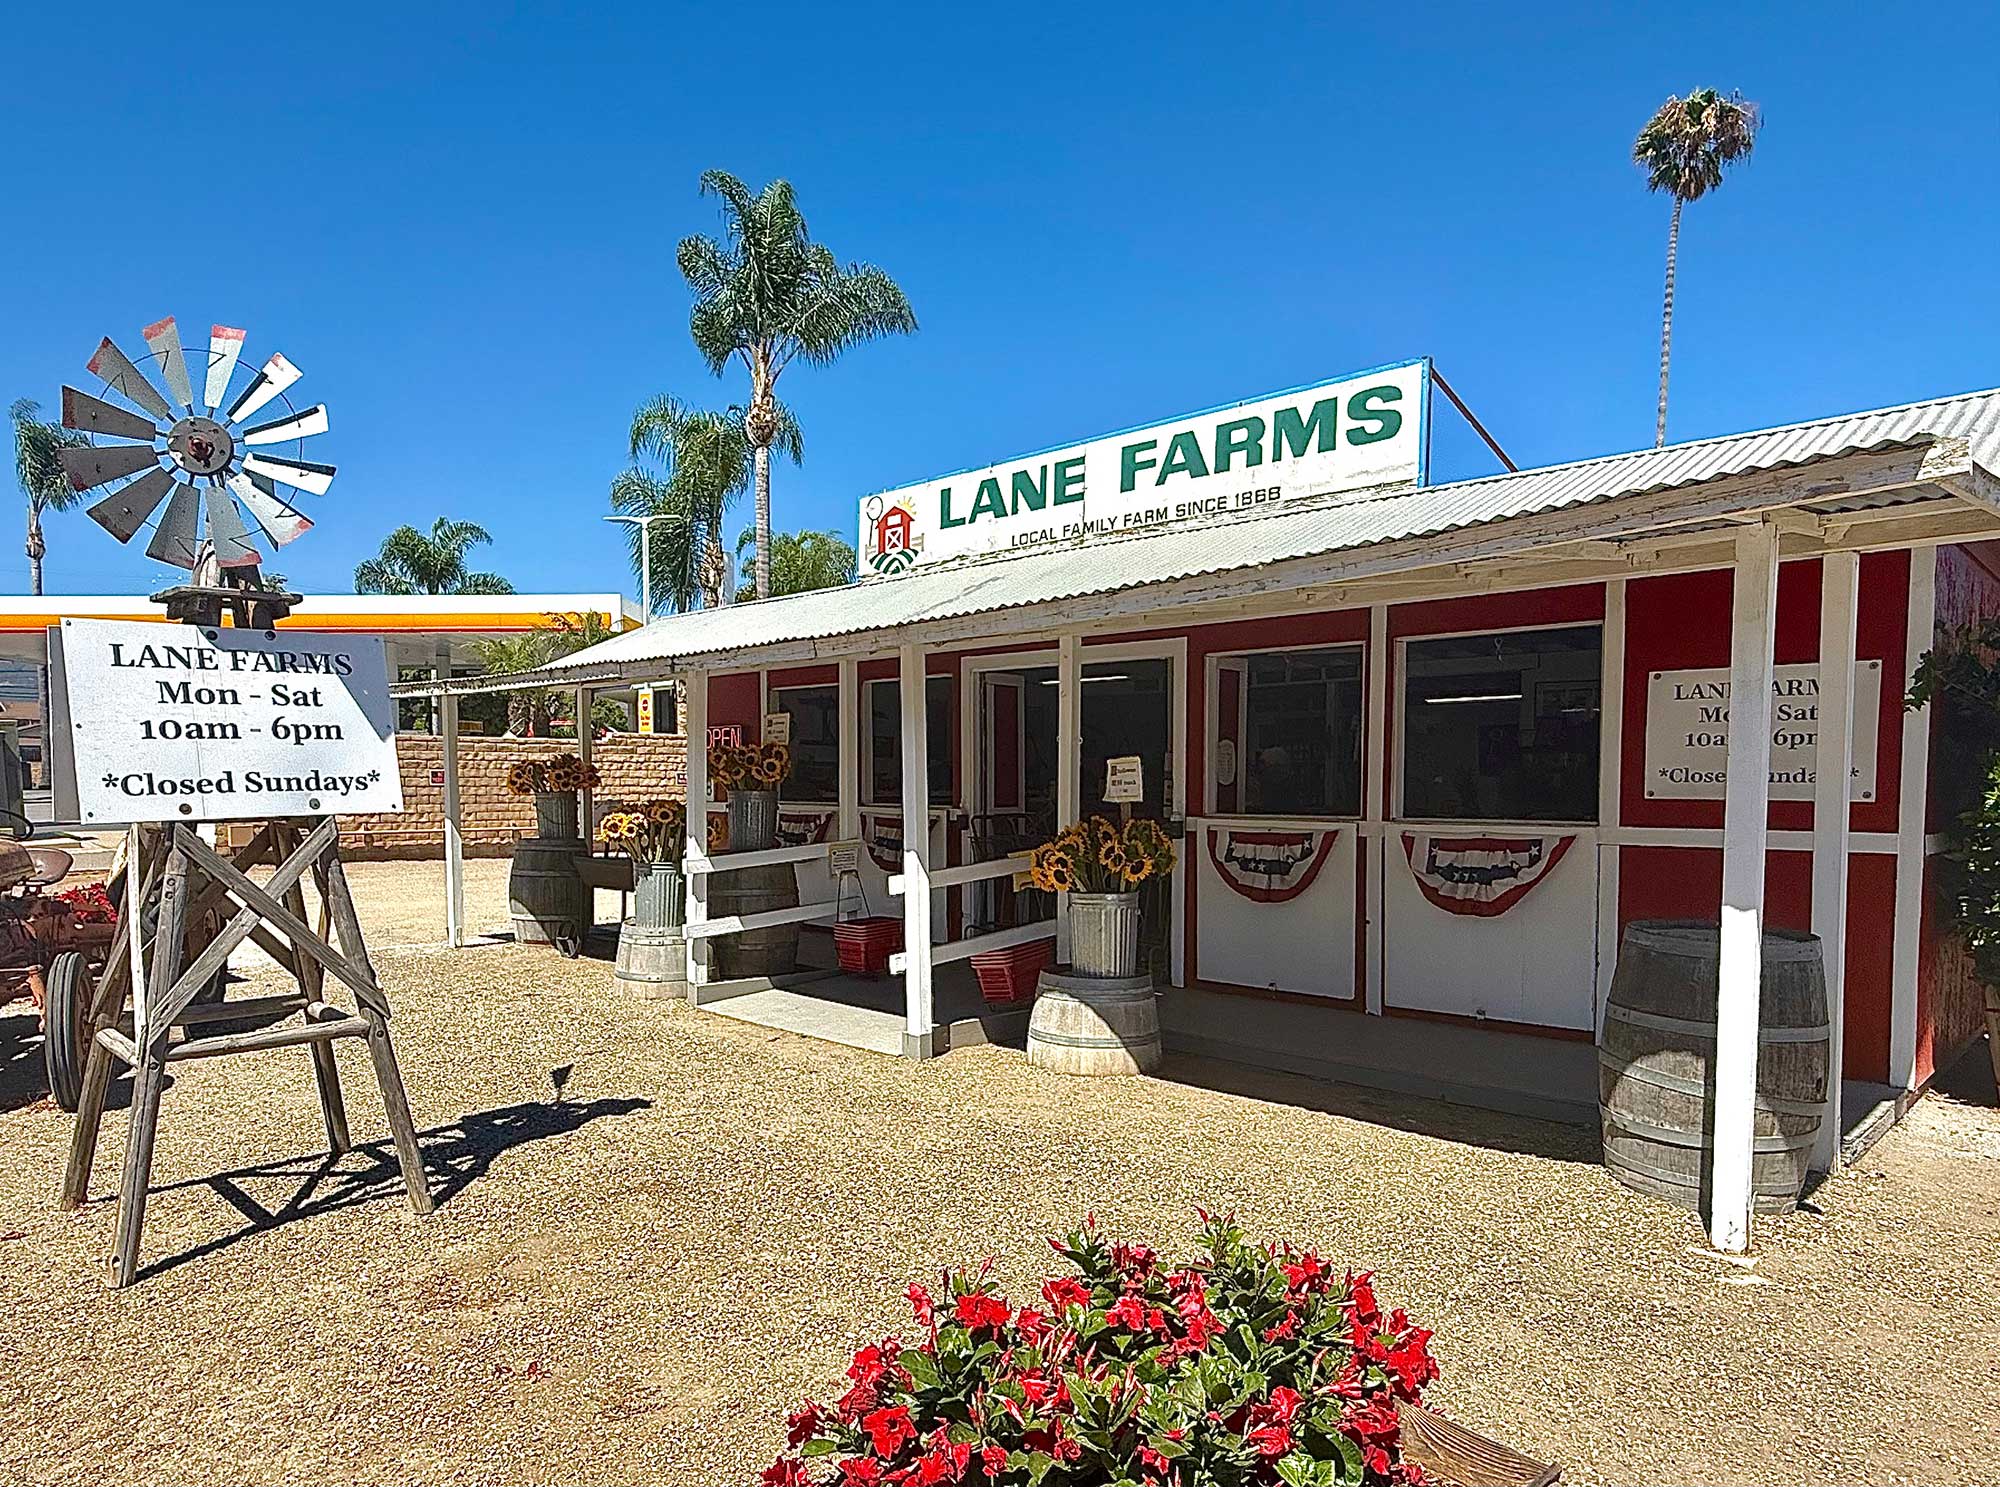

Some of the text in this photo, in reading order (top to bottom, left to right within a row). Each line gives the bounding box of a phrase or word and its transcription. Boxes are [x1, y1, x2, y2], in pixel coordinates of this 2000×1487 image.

[939, 385, 1404, 530] LANE FARMS
[1011, 486, 1282, 547] LOCAL FAMILY FARM SINCE 1868
[108, 643, 353, 675] LANE FARMS
[156, 680, 242, 705] Mon
[271, 683, 323, 707] Sat
[1674, 682, 1731, 700] LAN
[1777, 704, 1818, 721] Sat
[140, 719, 242, 740] 10am
[271, 716, 344, 746] 6pm
[1685, 732, 1728, 747] 10a
[1658, 767, 1727, 784] Close
